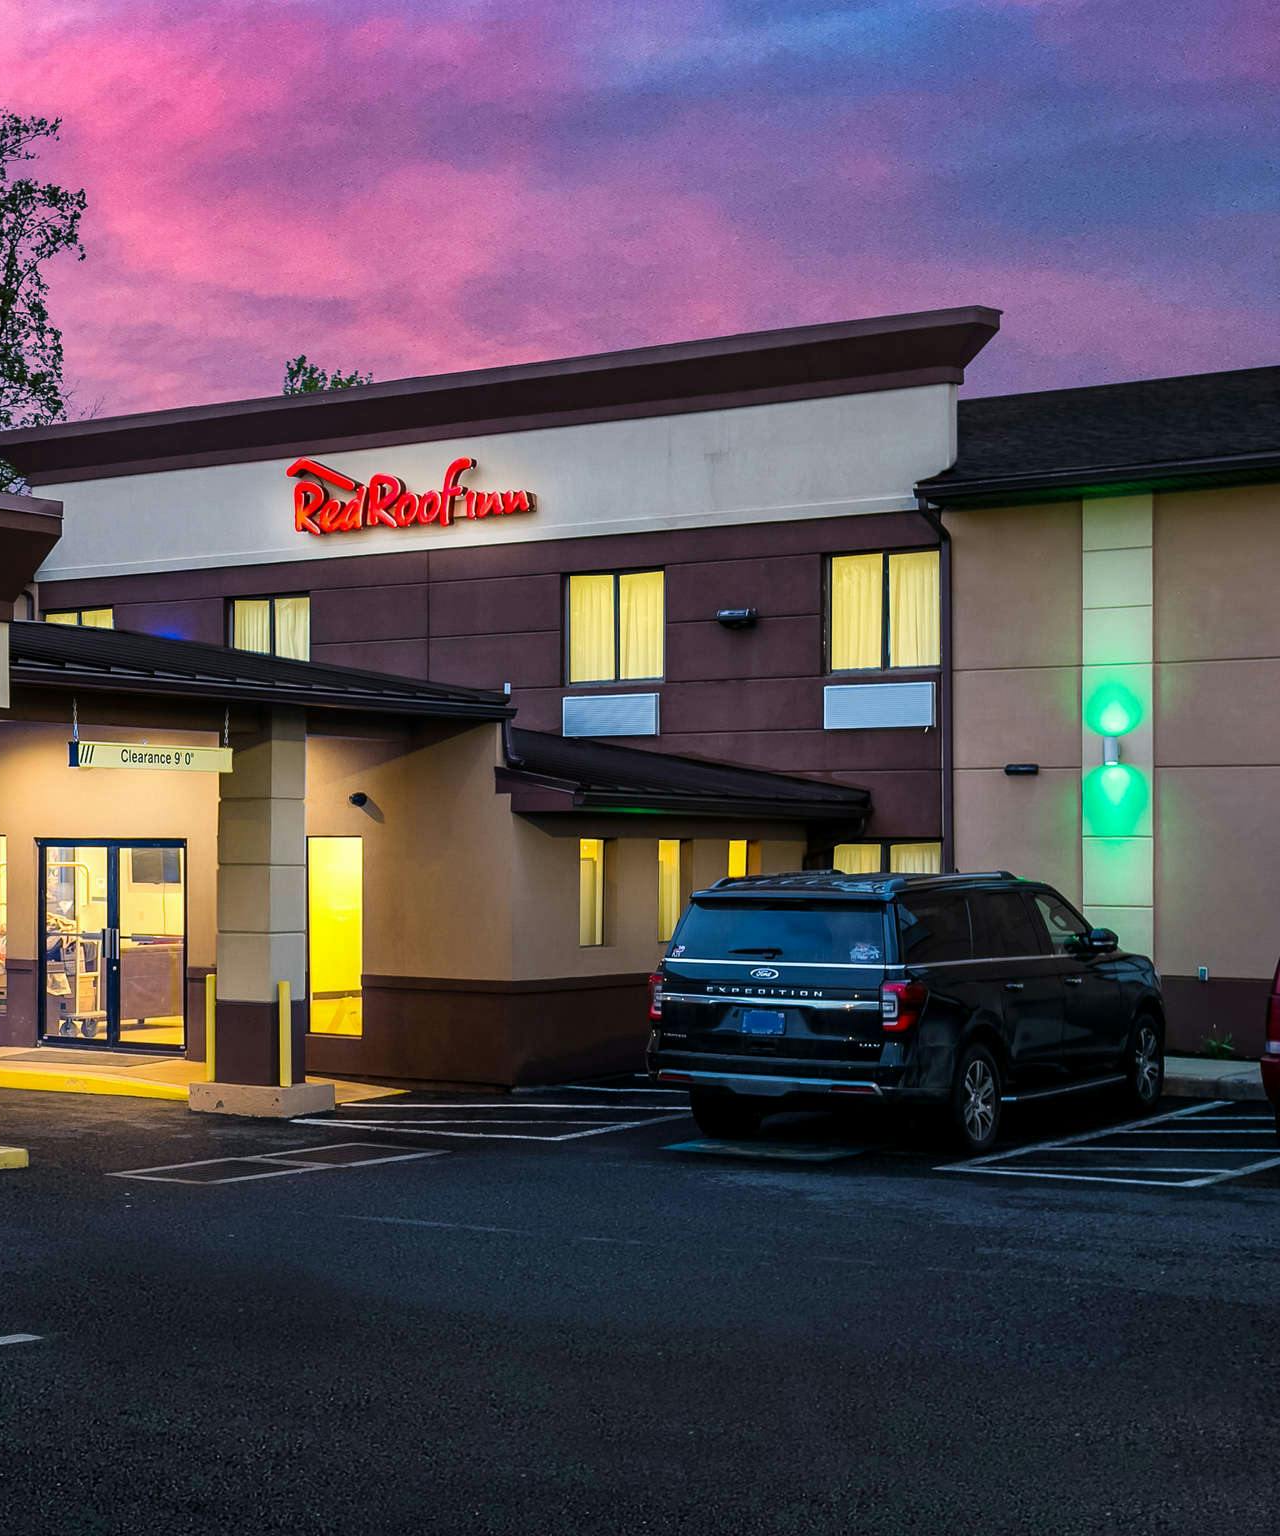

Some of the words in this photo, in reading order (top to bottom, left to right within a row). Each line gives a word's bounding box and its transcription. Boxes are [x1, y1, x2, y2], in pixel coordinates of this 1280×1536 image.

[294, 481, 364, 536] Red
[369, 457, 474, 528] Roof
[121, 749, 171, 764] Clearance
[705, 985, 824, 998] EXPEDITION
